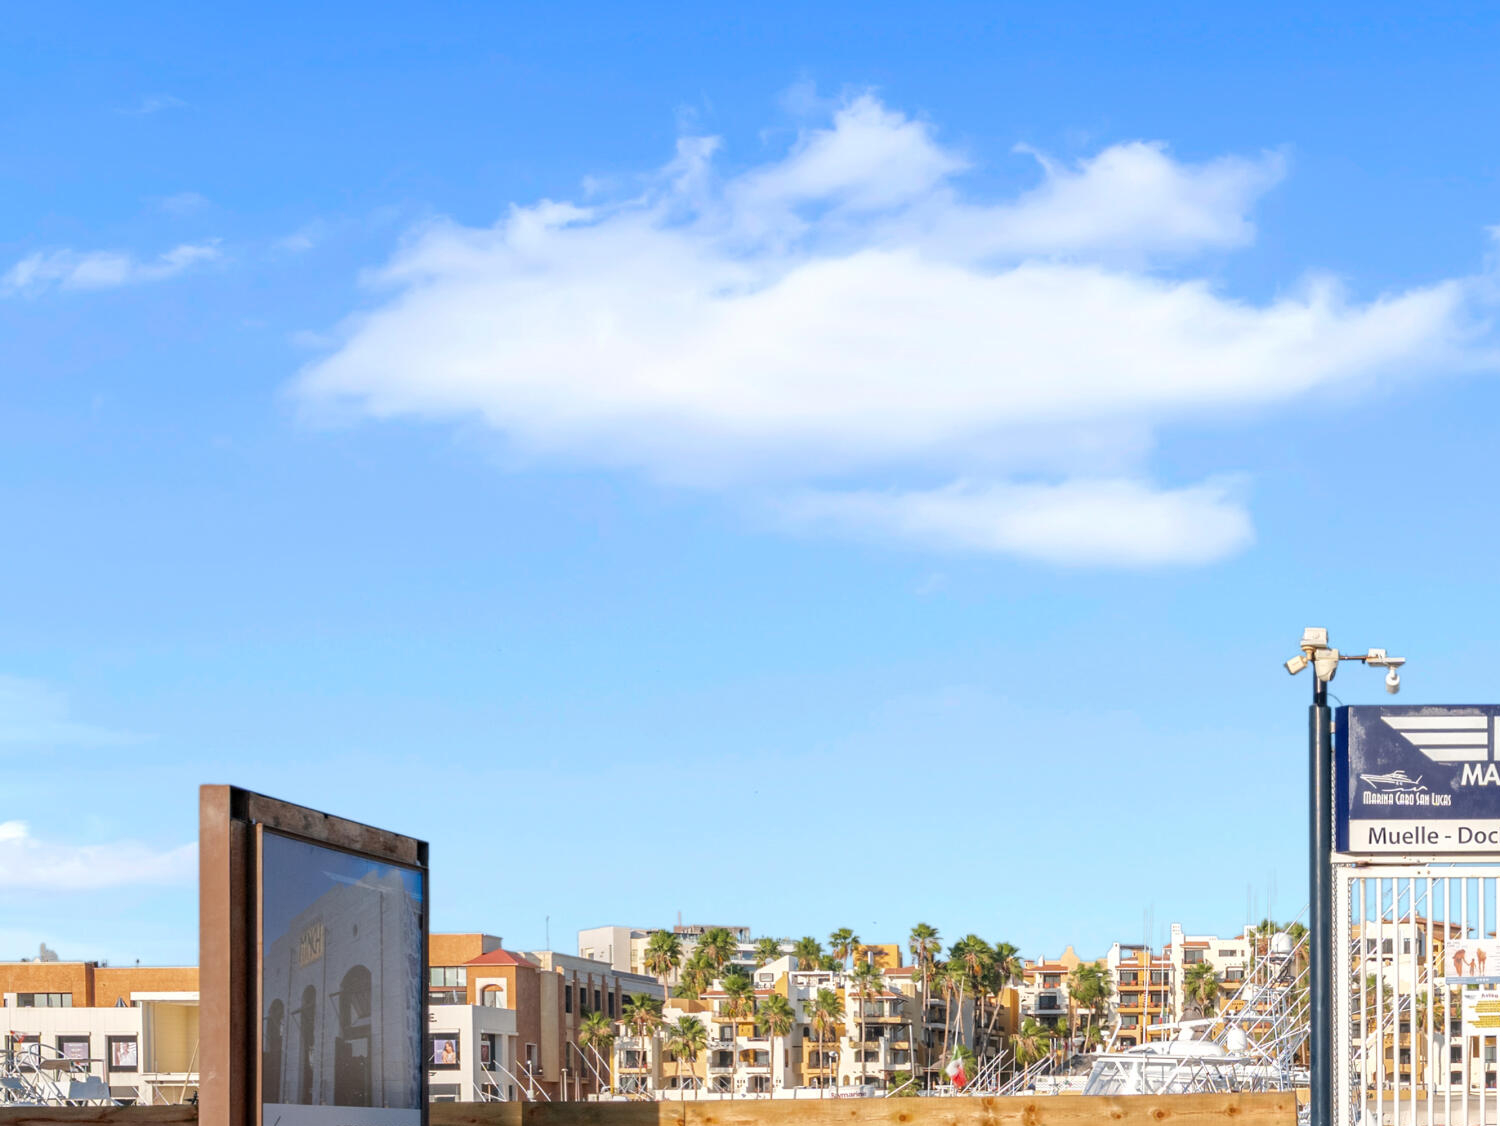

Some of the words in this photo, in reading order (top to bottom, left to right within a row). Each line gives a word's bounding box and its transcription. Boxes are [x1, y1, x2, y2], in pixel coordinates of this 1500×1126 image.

[1363, 791, 1394, 805] MARINA
[1396, 791, 1414, 805] CABO
[1431, 792, 1452, 806] LUCAS
[1368, 826, 1439, 845] Muelle
